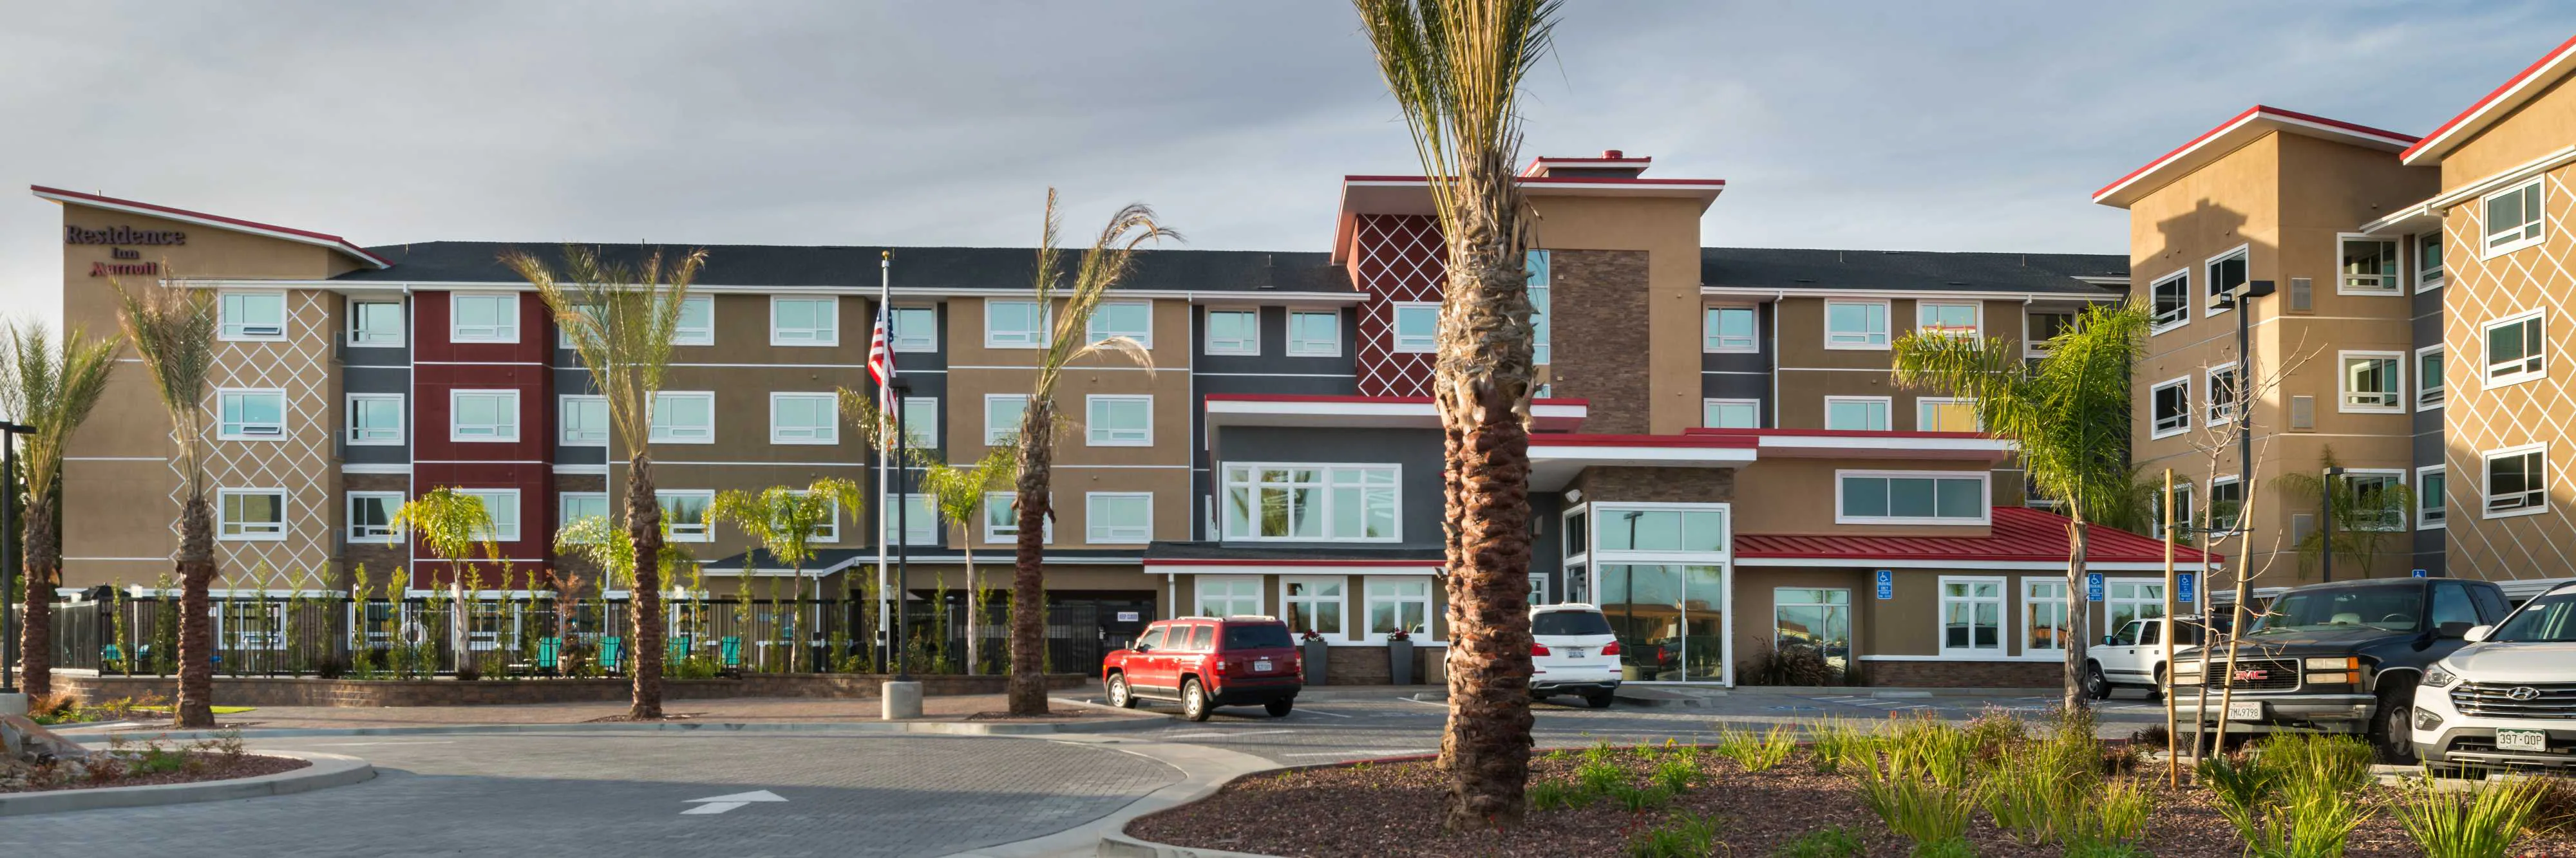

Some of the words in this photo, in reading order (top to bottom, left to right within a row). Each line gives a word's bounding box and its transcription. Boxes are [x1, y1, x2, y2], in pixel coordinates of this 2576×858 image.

[65, 225, 186, 245] Residence
[111, 247, 140, 259] Inn
[88, 261, 157, 277] Marriott
